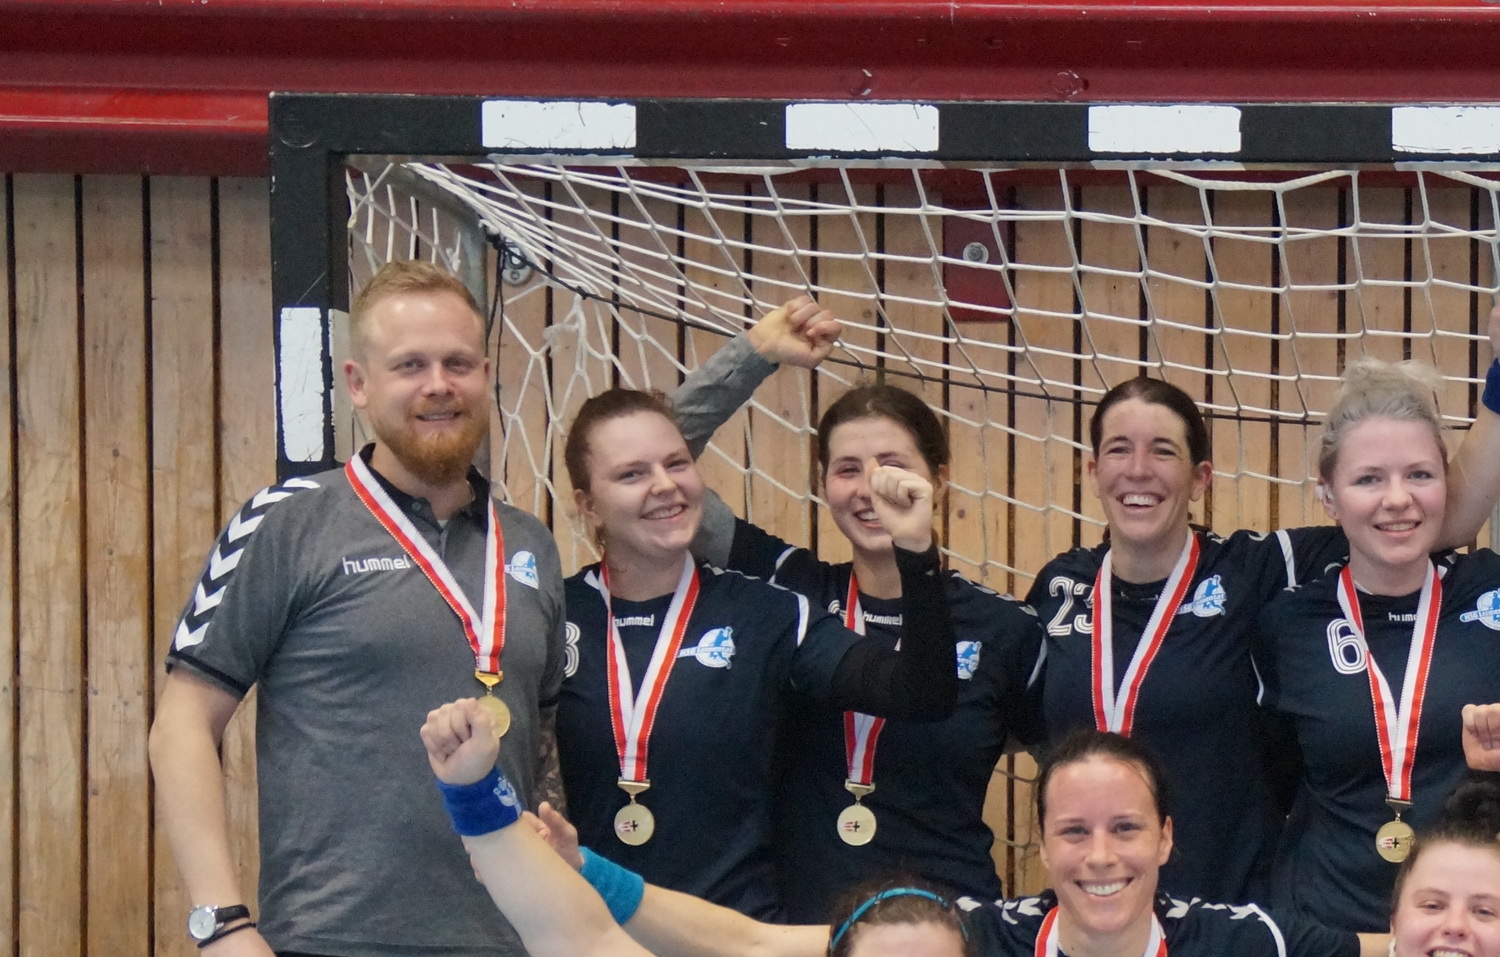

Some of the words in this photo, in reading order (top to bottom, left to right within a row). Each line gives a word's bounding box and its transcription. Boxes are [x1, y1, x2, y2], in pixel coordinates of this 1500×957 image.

[342, 554, 411, 576] hummel
[1047, 576, 1094, 637] 23
[1327, 618, 1367, 675] 6
